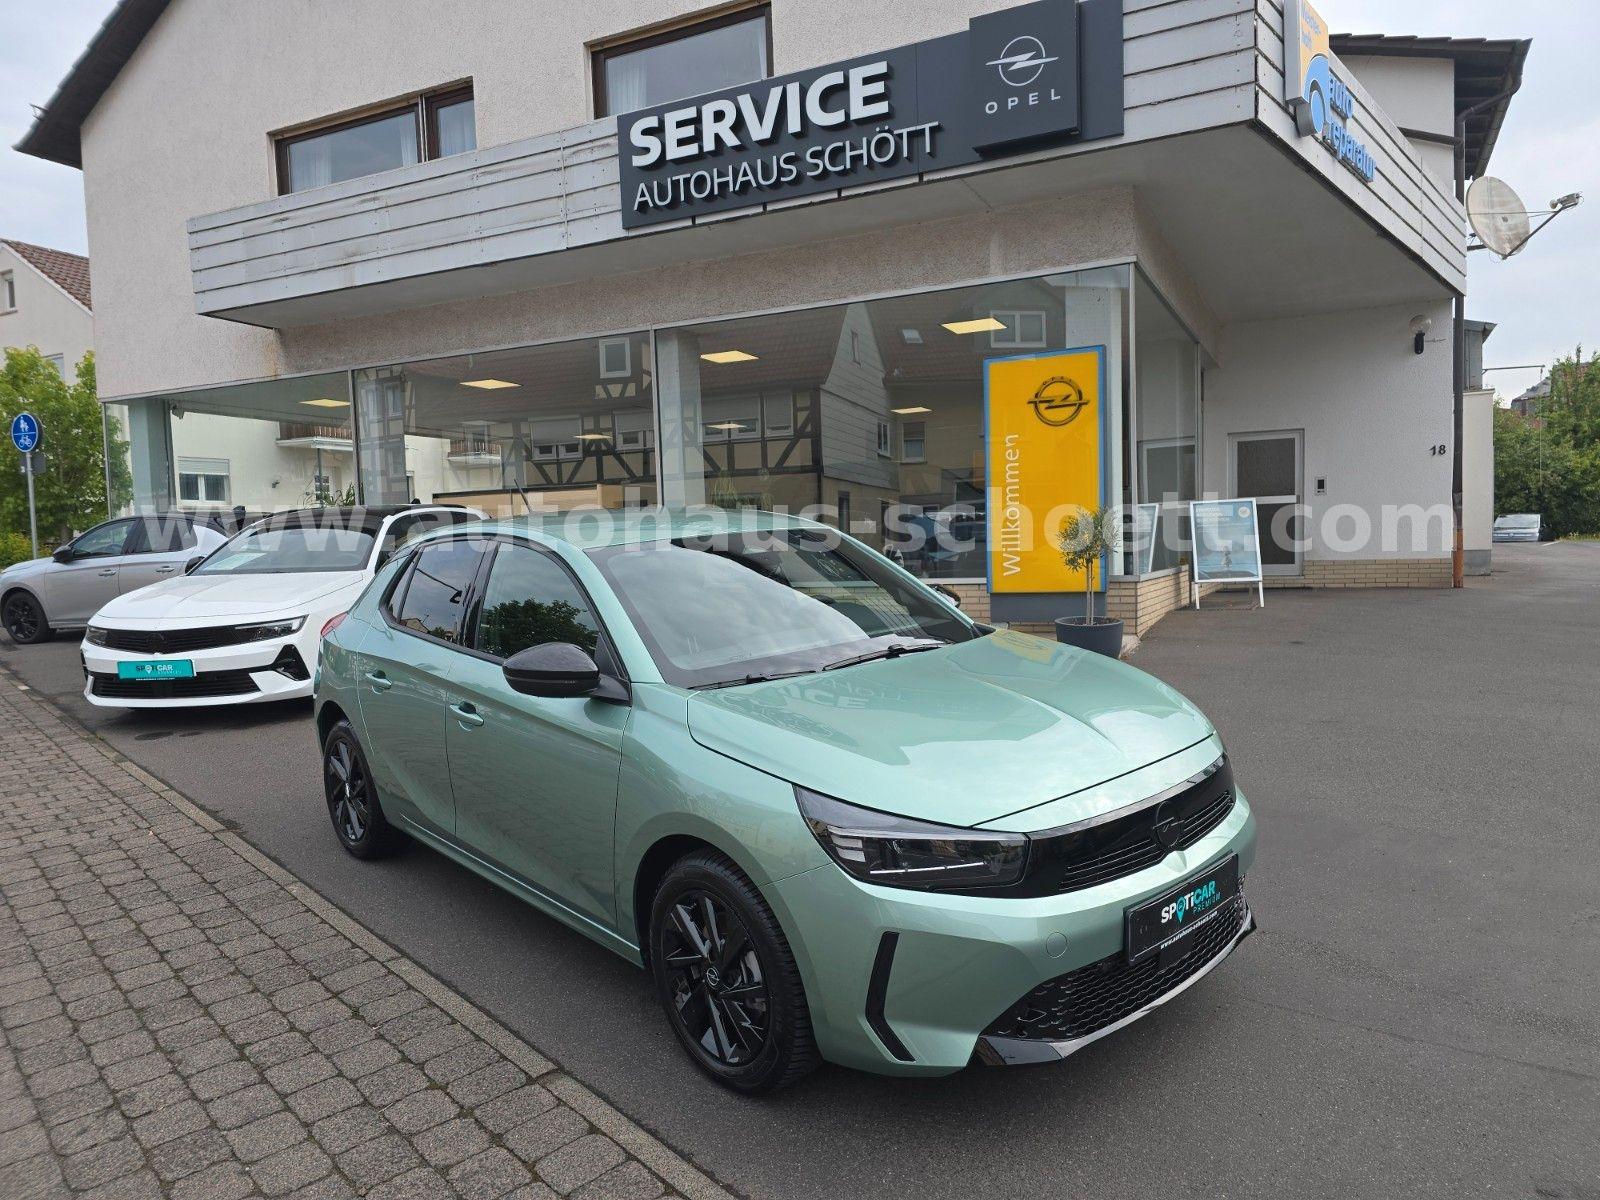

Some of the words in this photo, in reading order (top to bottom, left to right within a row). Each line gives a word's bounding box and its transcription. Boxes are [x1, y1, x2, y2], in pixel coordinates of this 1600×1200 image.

[630, 61, 889, 168] SERVICE
[985, 89, 1061, 115] OPEL
[633, 151, 797, 211] AUTOHAUS
[806, 121, 940, 178] SCHÖTT
[1429, 444, 1446, 456] 18
[1000, 433, 1021, 577] Willkommen
